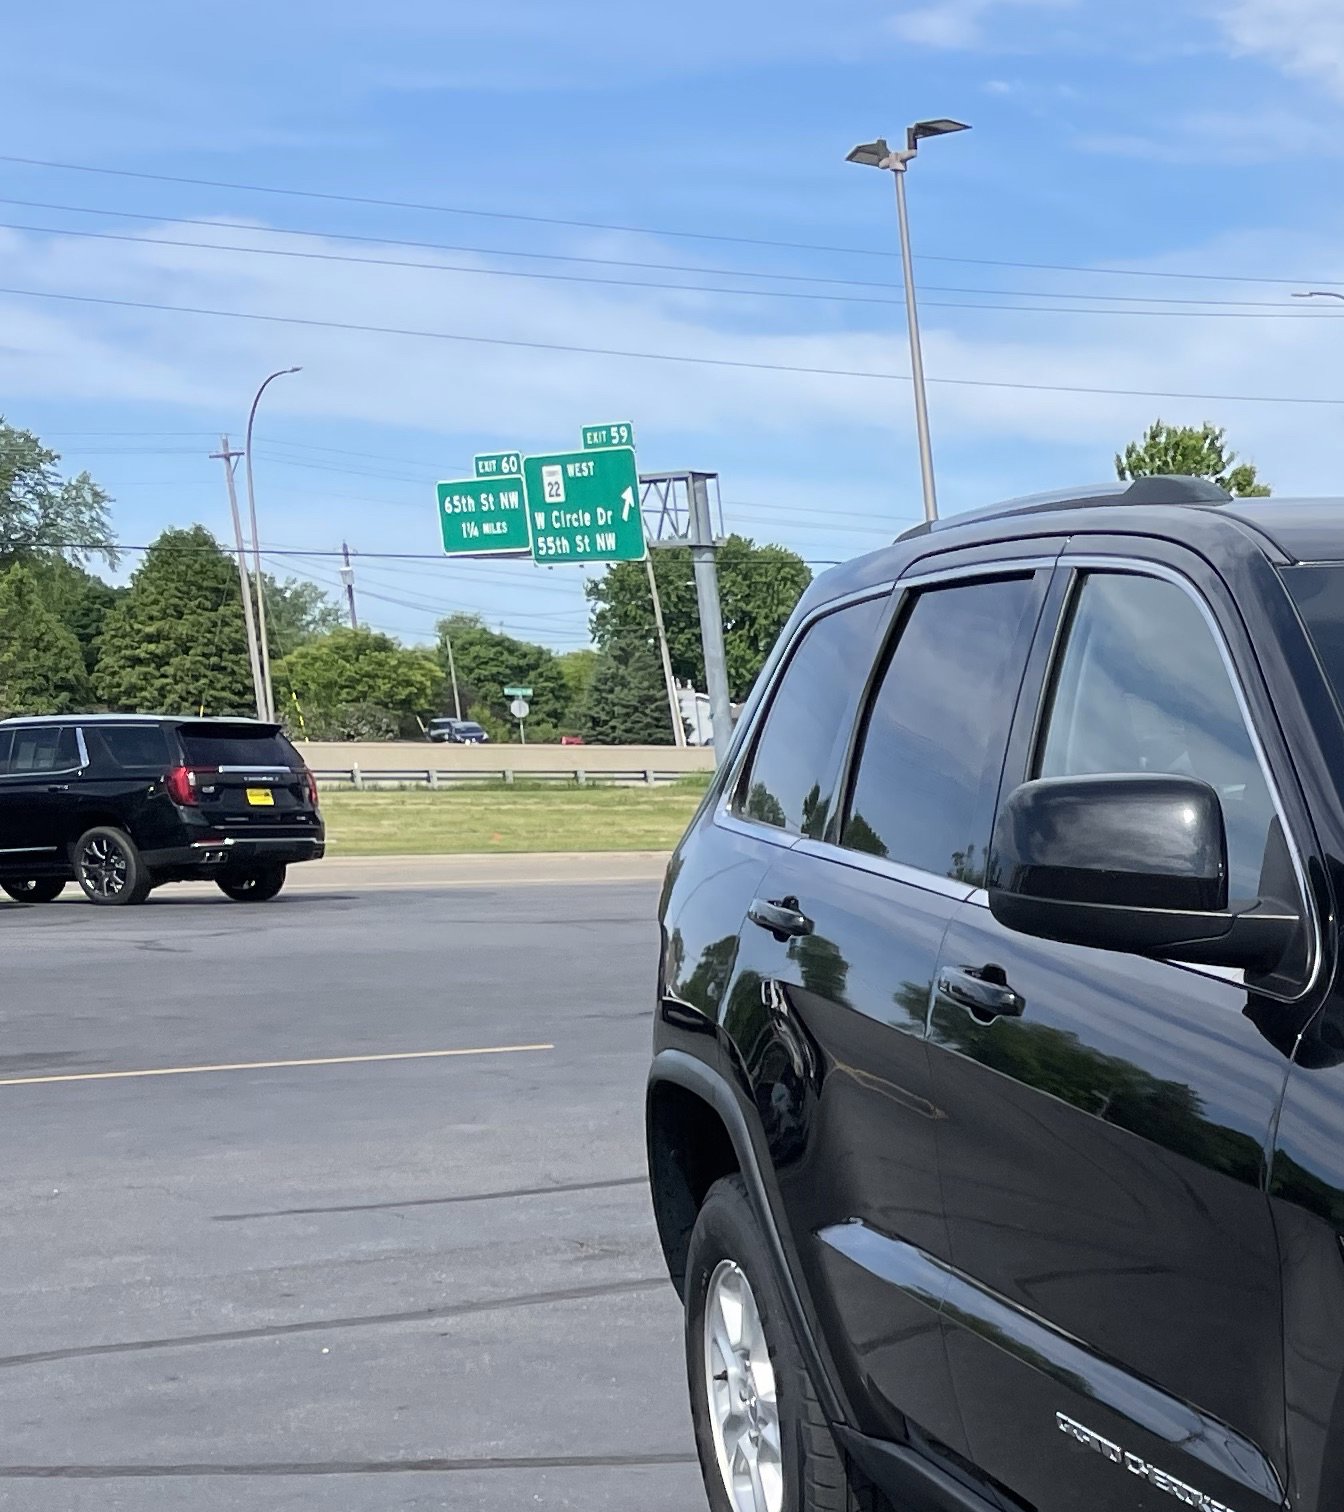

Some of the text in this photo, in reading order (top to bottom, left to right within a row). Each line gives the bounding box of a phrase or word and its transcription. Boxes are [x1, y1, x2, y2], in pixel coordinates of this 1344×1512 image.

[586, 425, 629, 444] EXIT 59
[478, 456, 518, 473] EXIT 60
[566, 461, 595, 478] WEST
[547, 481, 561, 497] 22
[444, 490, 519, 513] 65th St NW
[534, 506, 613, 530] W Circle Dr
[482, 521, 508, 535] MILES
[537, 532, 616, 555] 55th St NW
